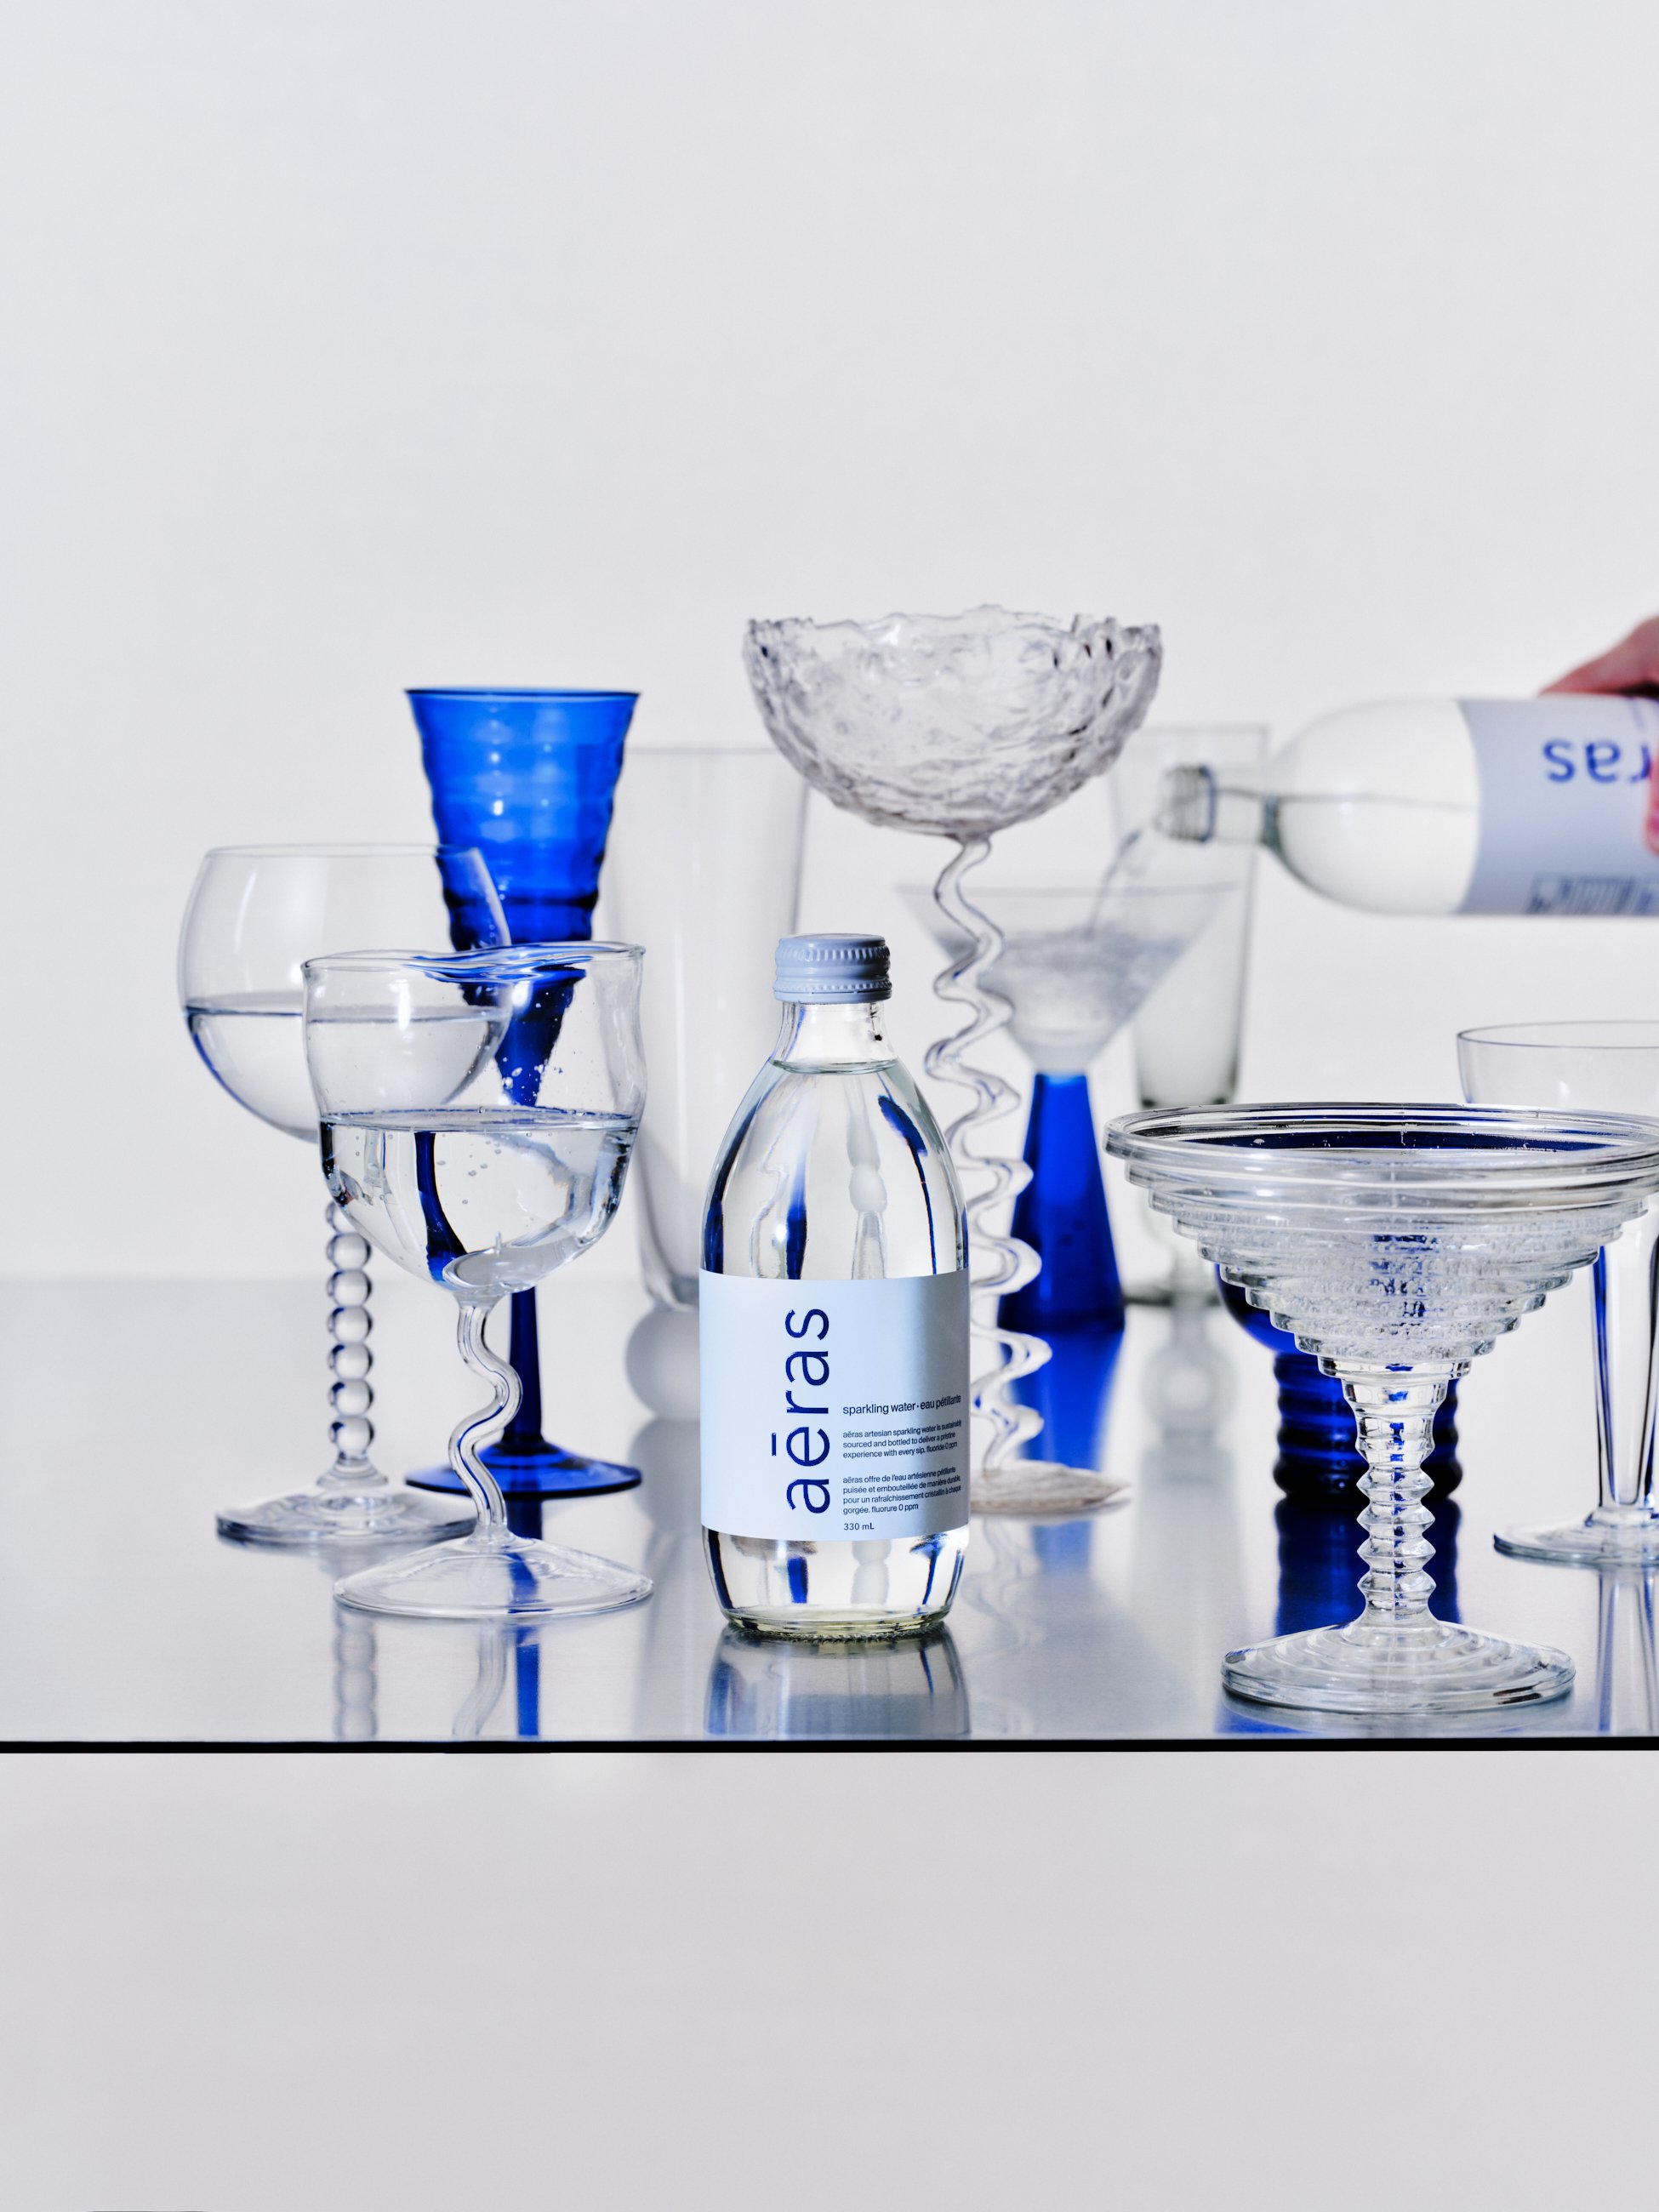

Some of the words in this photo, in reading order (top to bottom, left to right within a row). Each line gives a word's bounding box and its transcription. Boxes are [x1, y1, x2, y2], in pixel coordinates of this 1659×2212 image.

[1543, 738, 1651, 784] ras
[771, 1308, 830, 1514] aēras
[843, 1404, 889, 1416] sparkling
[892, 1403, 915, 1411] water
[921, 1401, 934, 1410] eau
[936, 1394, 961, 1409] pétillante
[864, 1429, 892, 1438] artesian
[893, 1428, 921, 1436] sparkling
[888, 1438, 910, 1446] bottled
[941, 1432, 955, 1440] pristine
[843, 1451, 882, 1459] experience
[898, 1448, 915, 1457] every
[908, 1471, 936, 1479] artésienne
[843, 1486, 867, 1495] puisée
[877, 1481, 918, 1491] embouteillée
[927, 1478, 946, 1487] manière
[871, 1492, 924, 1502] rafraîchissement
[843, 1505, 870, 1515] gorgée.
[871, 1504, 897, 1513] fluorure
[904, 1502, 918, 1511] ppm
